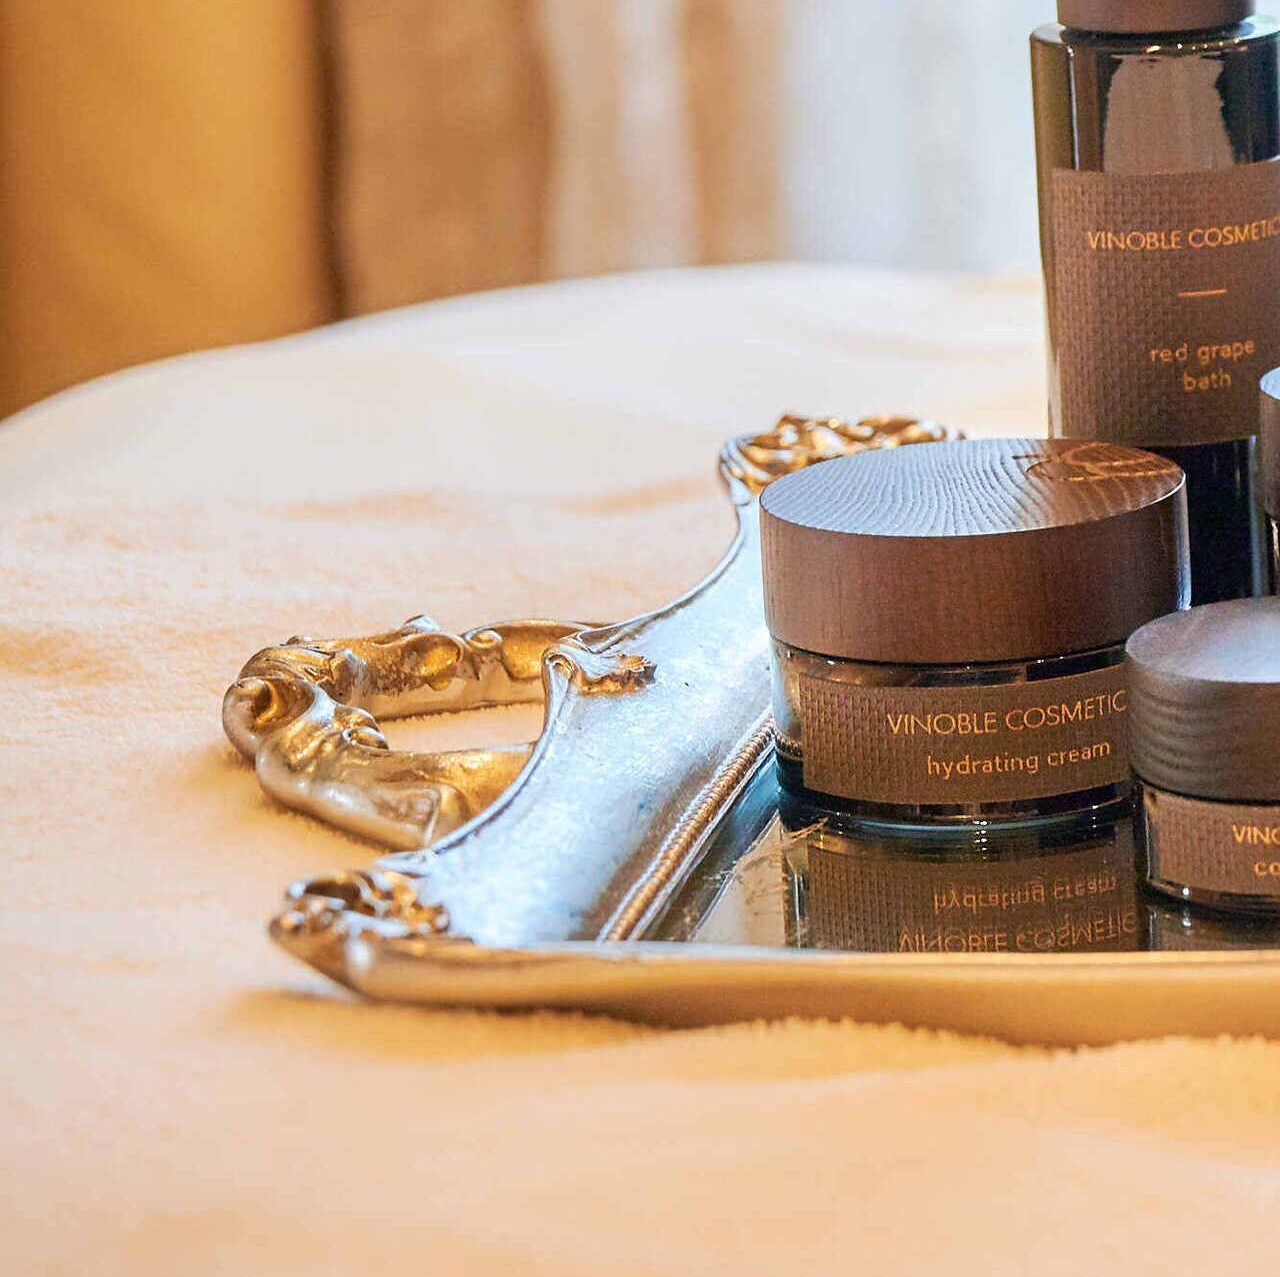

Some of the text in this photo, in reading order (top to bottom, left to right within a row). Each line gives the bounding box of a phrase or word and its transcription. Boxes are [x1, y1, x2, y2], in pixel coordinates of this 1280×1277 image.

[1087, 229, 1183, 251] VINOBLE
[1150, 339, 1257, 366] red grape
[1183, 369, 1232, 392] bath
[887, 690, 1128, 736] VINOBLE COSMETIC
[927, 741, 1112, 780] hydrating cream
